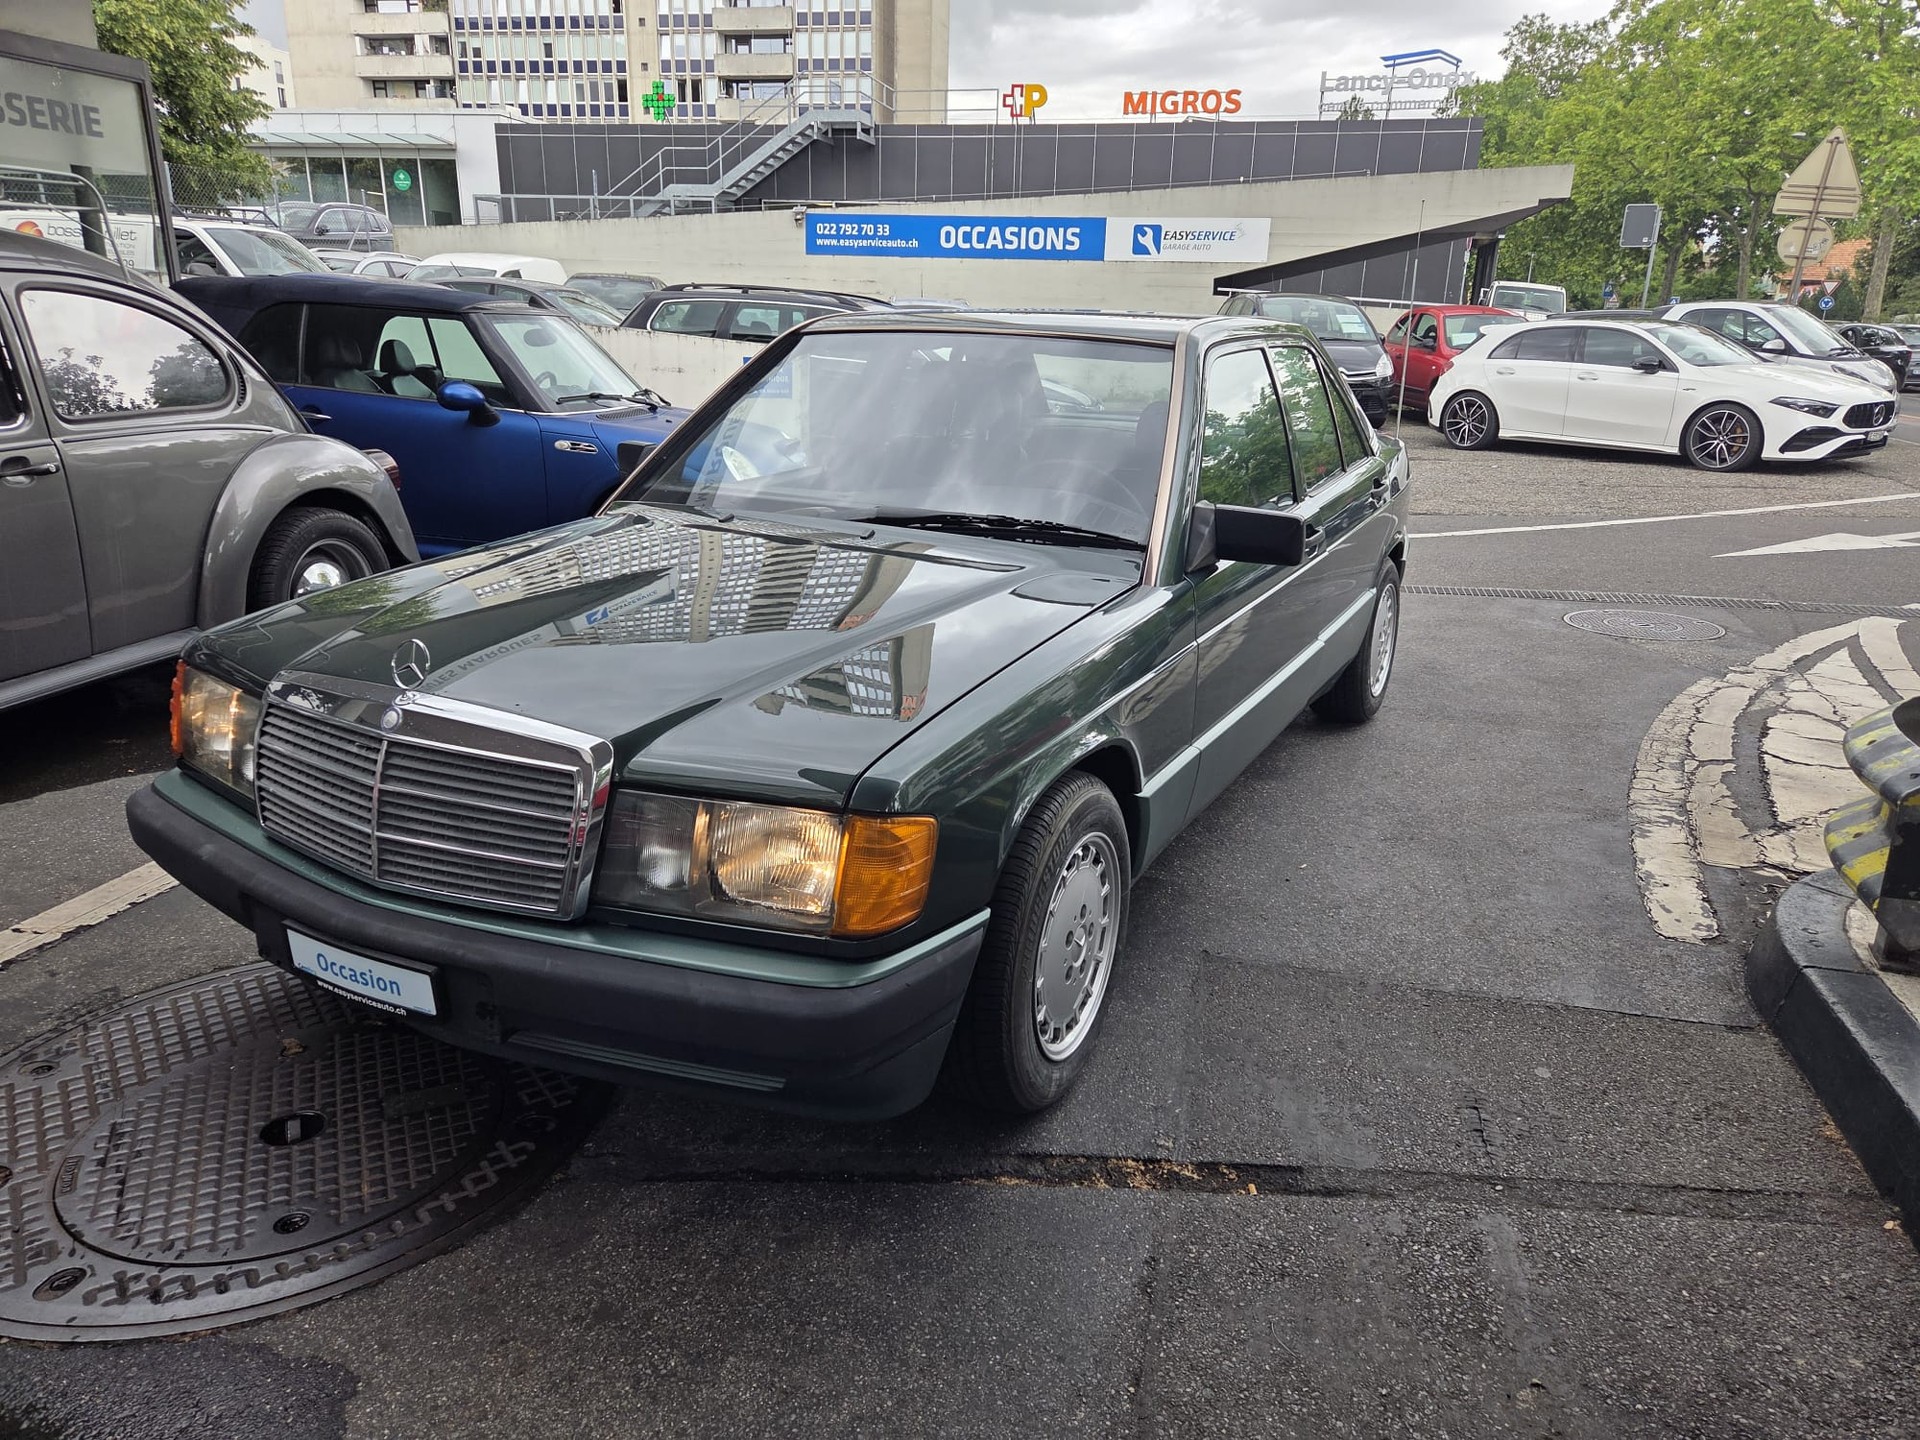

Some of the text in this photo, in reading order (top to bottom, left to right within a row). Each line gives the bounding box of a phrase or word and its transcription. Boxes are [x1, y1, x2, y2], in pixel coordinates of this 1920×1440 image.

[1122, 89, 1242, 115] MIGROS
[816, 223, 890, 236] 022 792 70 33
[940, 225, 1081, 251] OCCASIONS
[1163, 230, 1237, 241] EASYSERVICE
[816, 237, 918, 249] www.easyserviceauto.ch
[1162, 243, 1212, 251] GARAGE AUTO
[316, 953, 401, 996] Occasion
[316, 979, 407, 1017] www.easyserviceauto.ch
